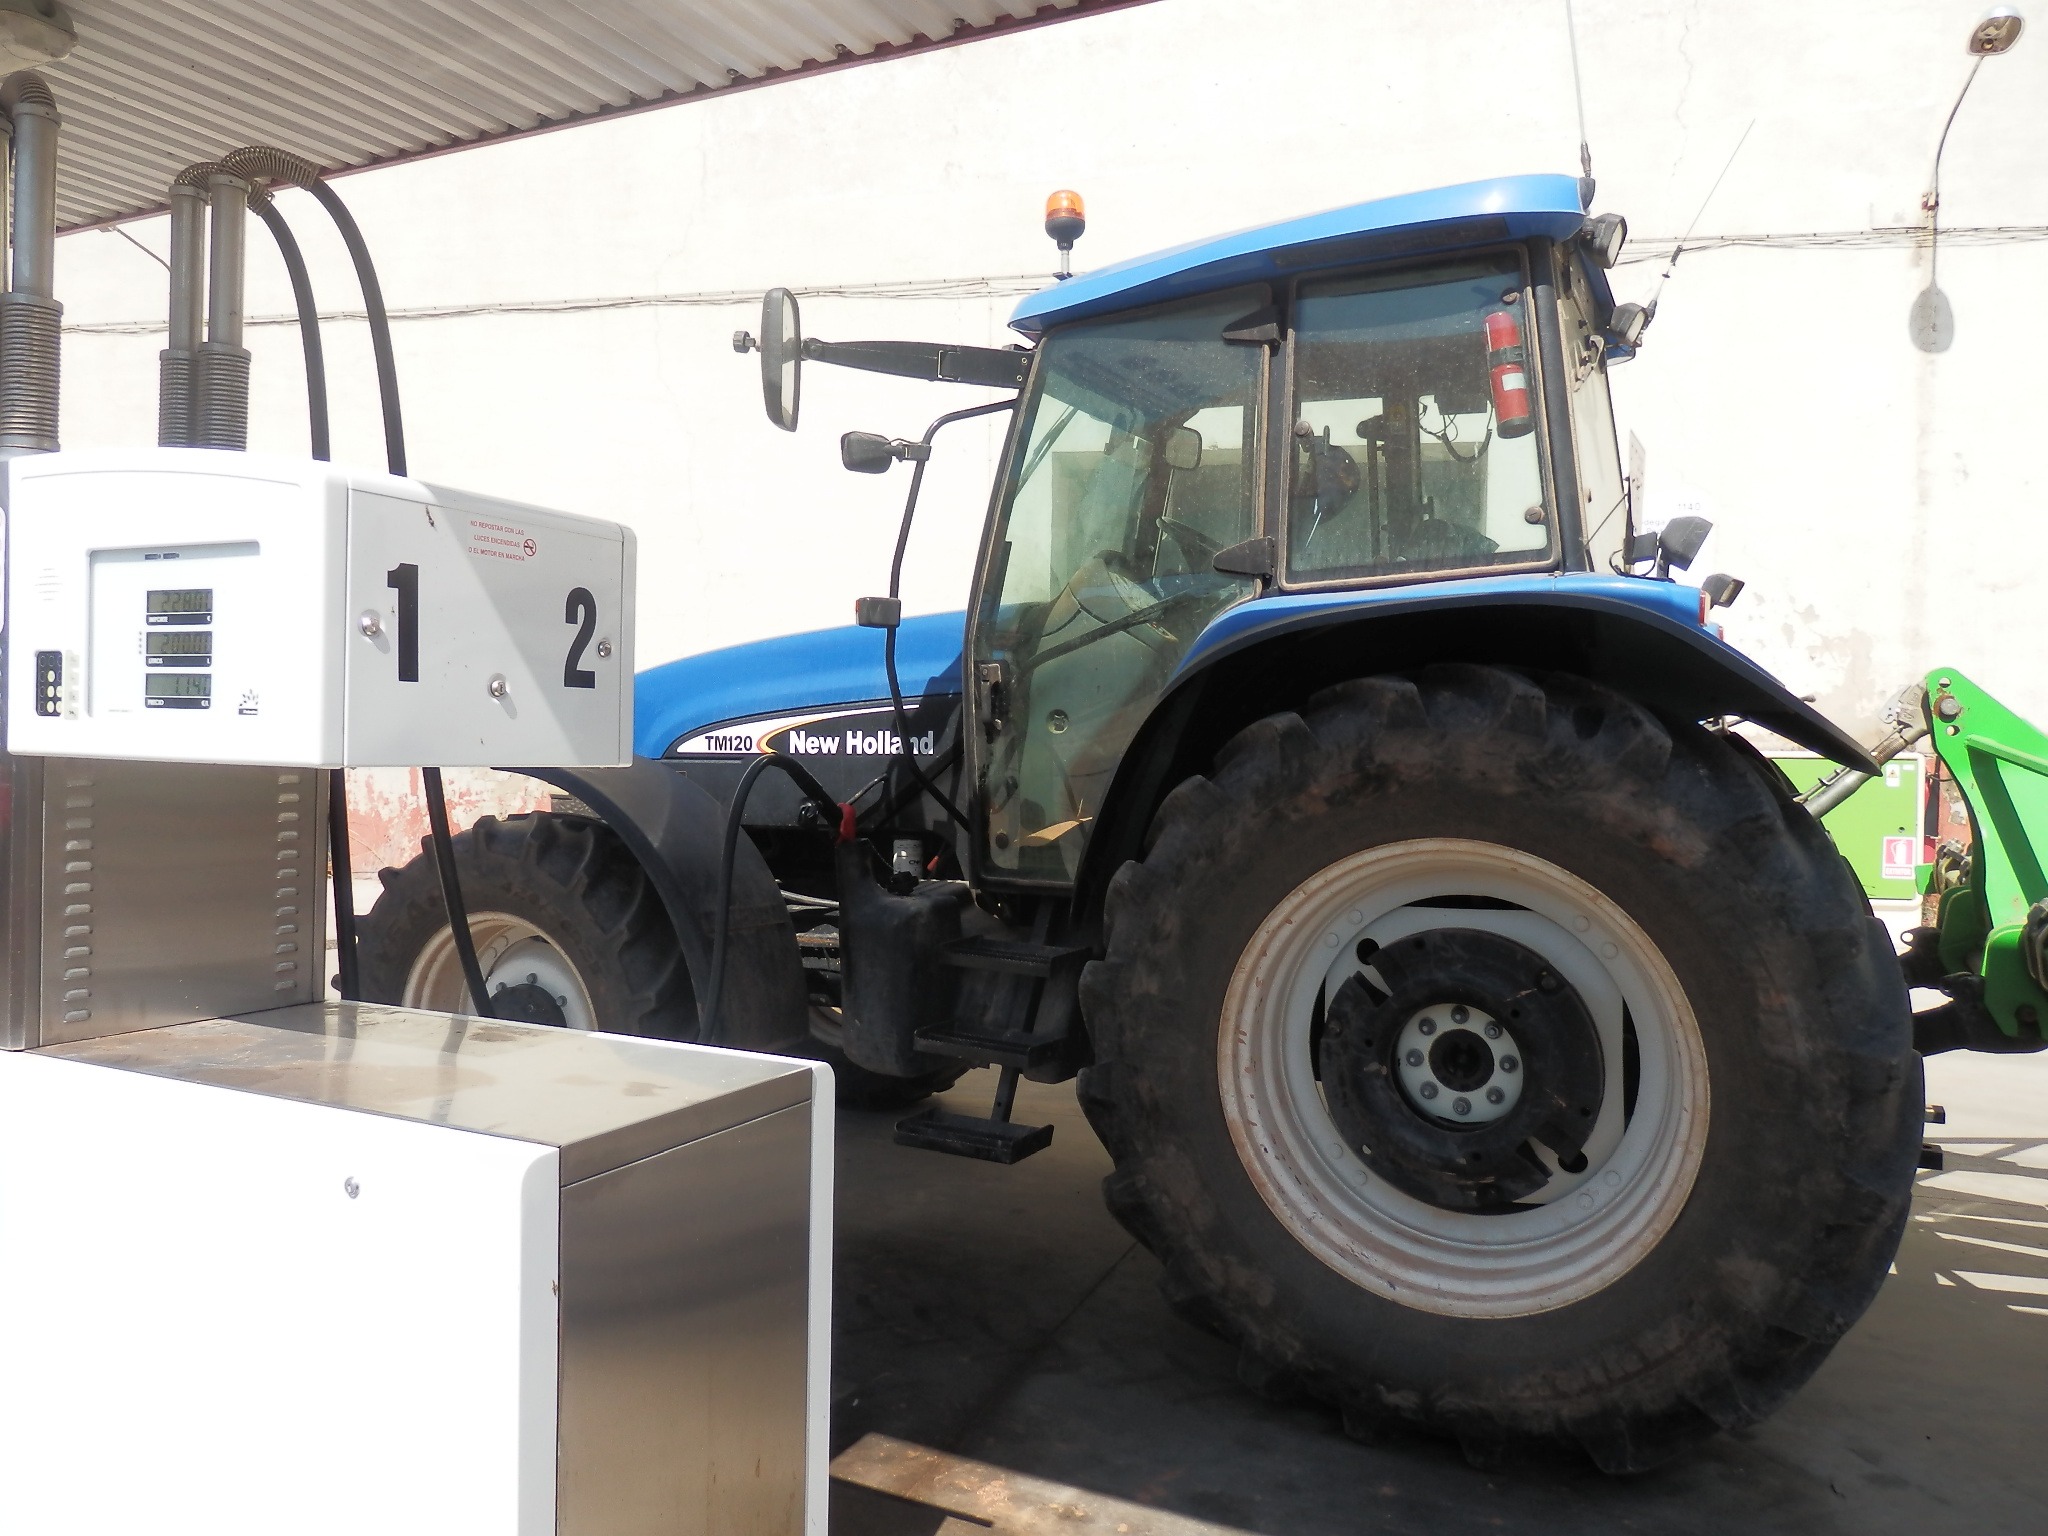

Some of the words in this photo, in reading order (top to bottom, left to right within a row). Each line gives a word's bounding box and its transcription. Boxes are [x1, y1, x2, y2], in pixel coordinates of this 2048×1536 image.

[478, 522, 503, 531] REPOSTAR
[491, 537, 520, 547] ENCENDIDAS
[480, 549, 497, 557] MOTOR
[505, 553, 525, 561] MARCHA
[387, 563, 419, 683] 1
[564, 586, 598, 689] 2
[704, 735, 753, 752] TM120
[789, 730, 840, 755] New
